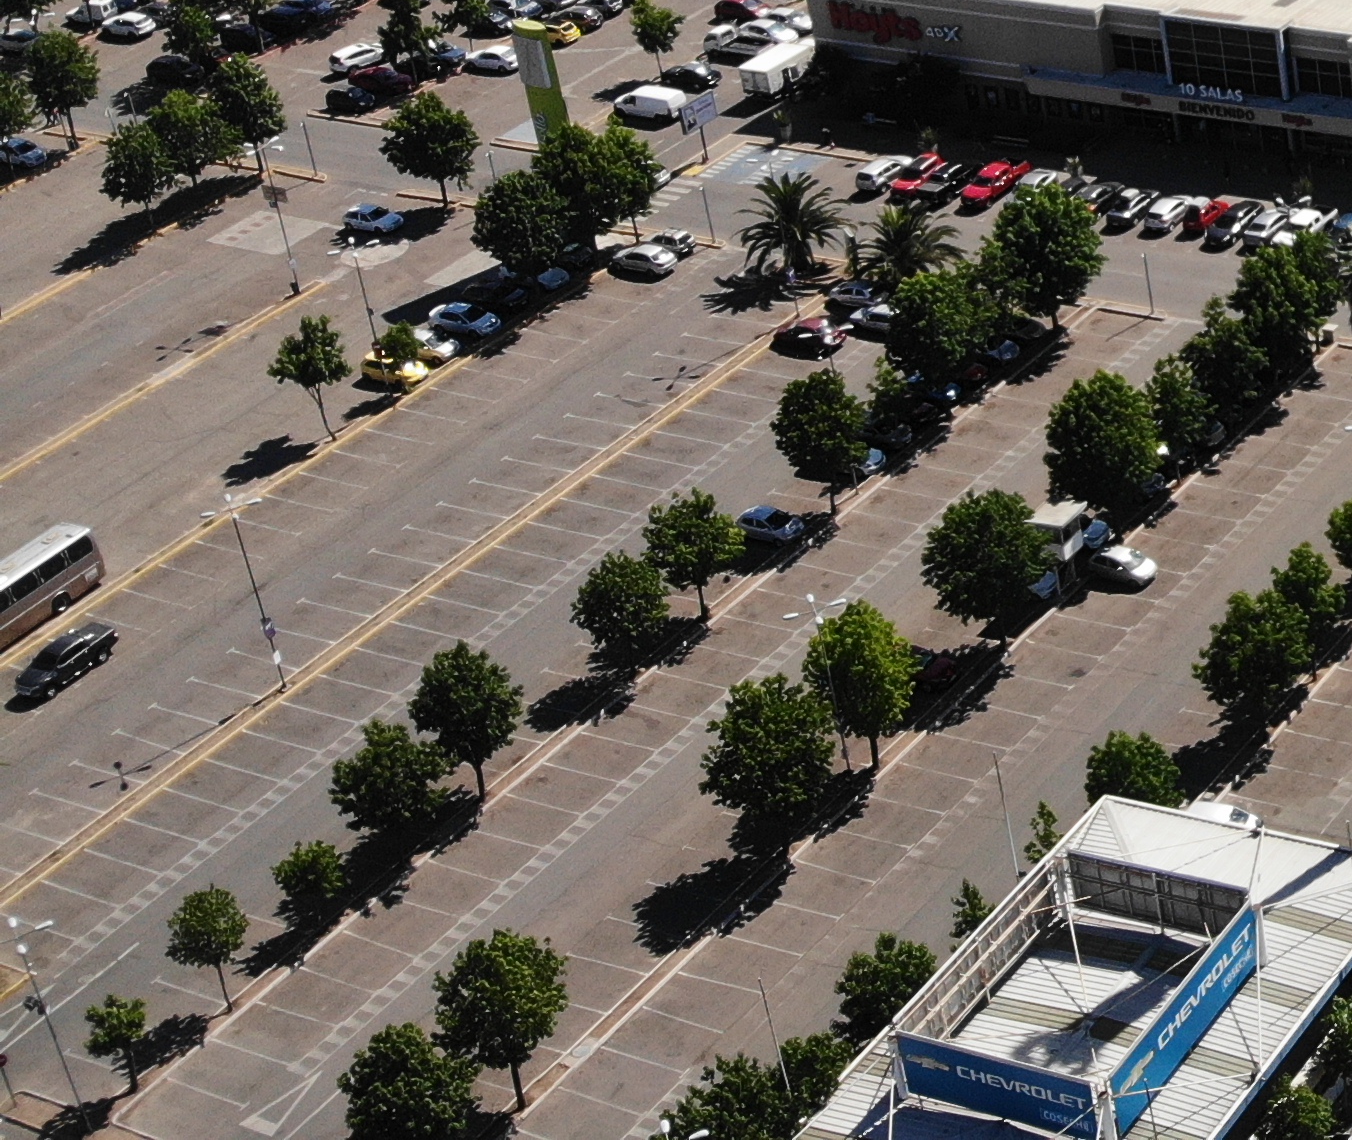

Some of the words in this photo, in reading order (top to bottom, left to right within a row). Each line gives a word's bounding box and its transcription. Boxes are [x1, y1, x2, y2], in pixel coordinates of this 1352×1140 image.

[826, 0, 923, 44] Hoyts
[1178, 82, 1194, 96] 10
[1200, 84, 1244, 102] SALAS
[1178, 100, 1255, 121] BIENVENIDO
[1158, 922, 1251, 1050] CHEVROLET
[956, 1065, 1086, 1110] CHEVROLET
